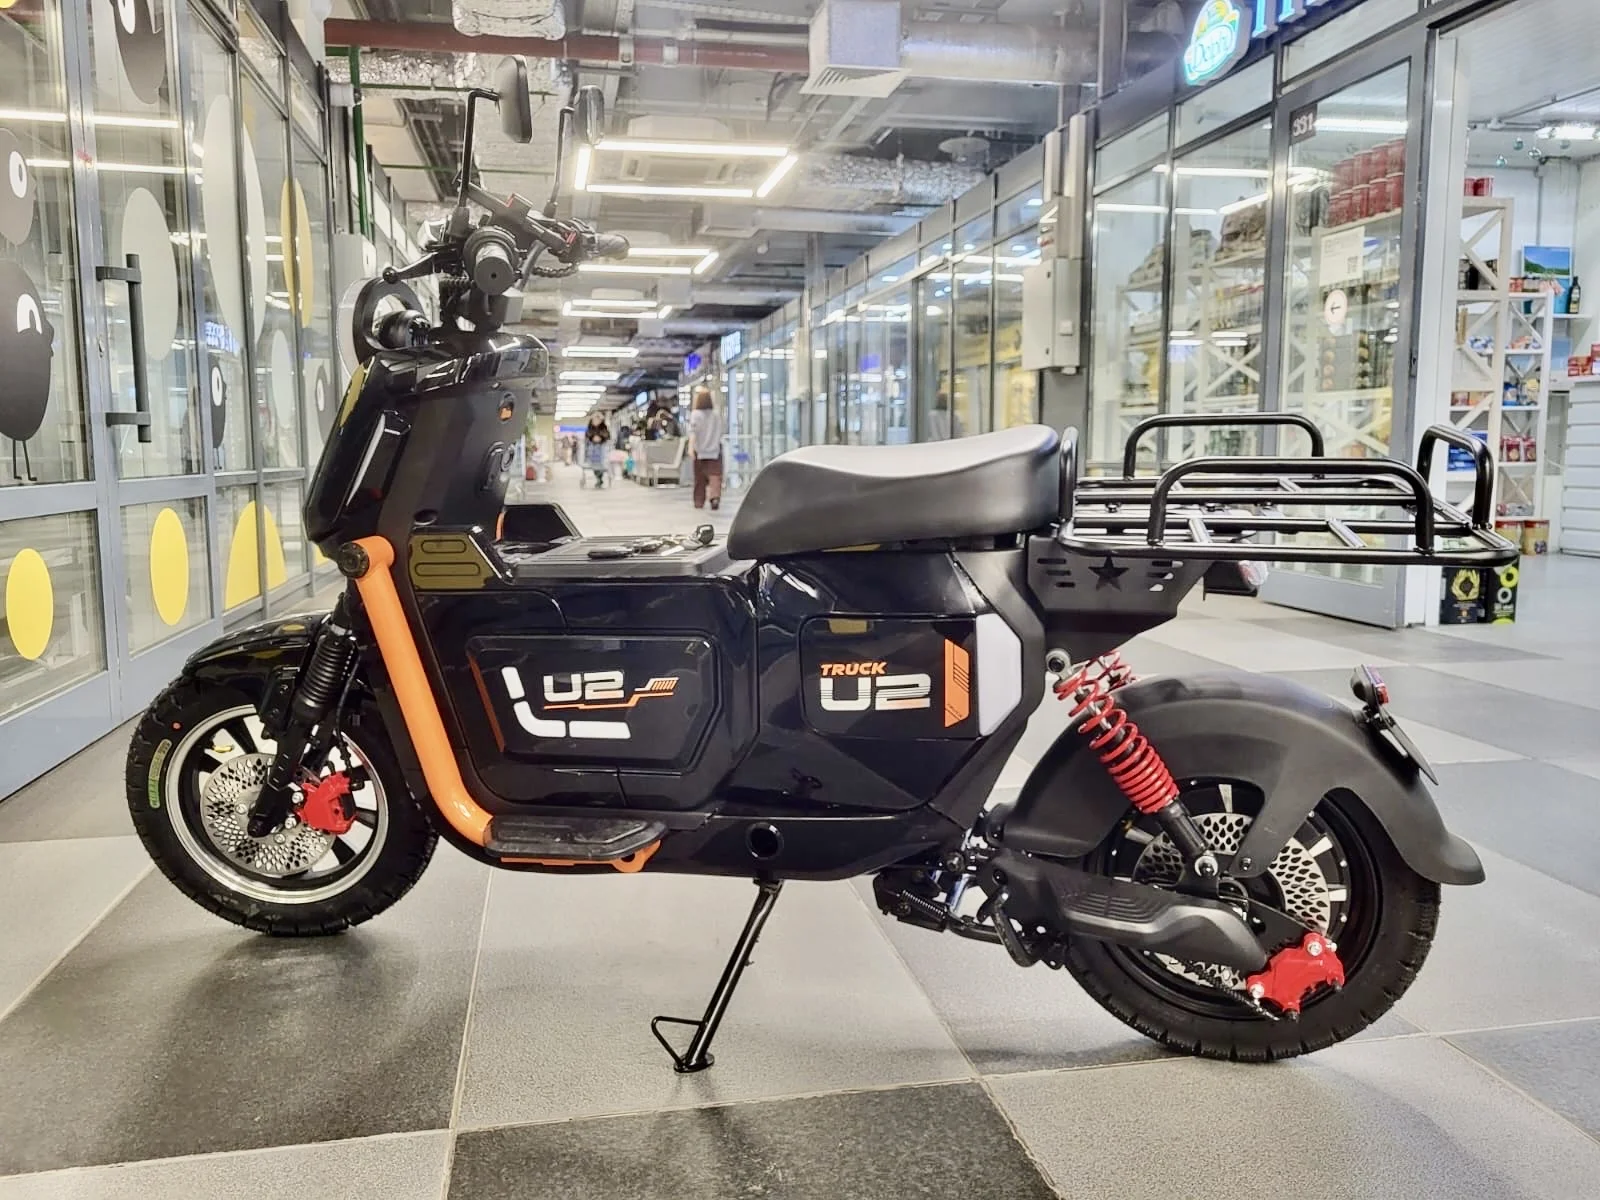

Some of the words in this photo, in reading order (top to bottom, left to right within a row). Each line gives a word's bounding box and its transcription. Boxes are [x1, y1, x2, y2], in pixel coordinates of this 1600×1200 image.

[820, 661, 887, 676] TRUCK
[543, 670, 625, 702] U2
[820, 673, 931, 711] U2
